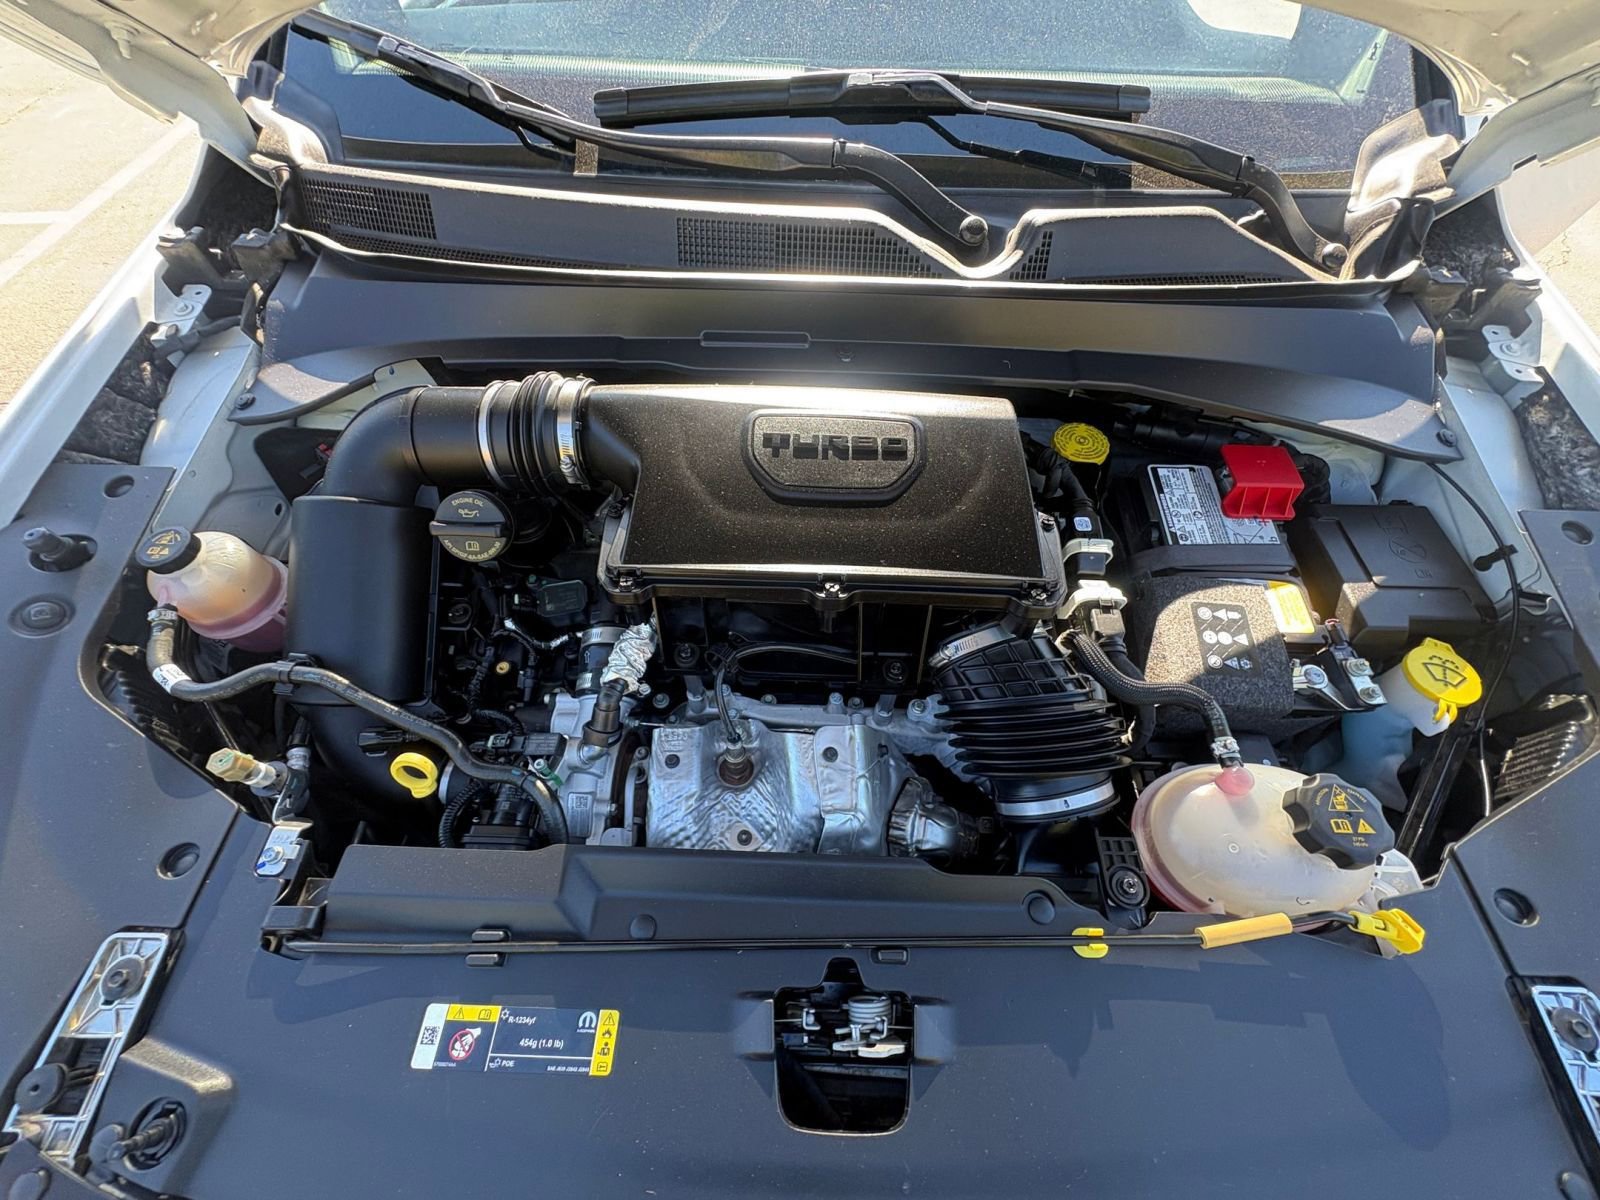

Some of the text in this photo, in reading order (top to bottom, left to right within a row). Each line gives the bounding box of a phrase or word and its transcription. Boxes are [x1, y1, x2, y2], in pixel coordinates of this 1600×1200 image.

[762, 432, 908, 461] TURBO
[508, 1016, 537, 1025] R-1234yf
[519, 1038, 564, 1050] 454g (1.0 lb)
